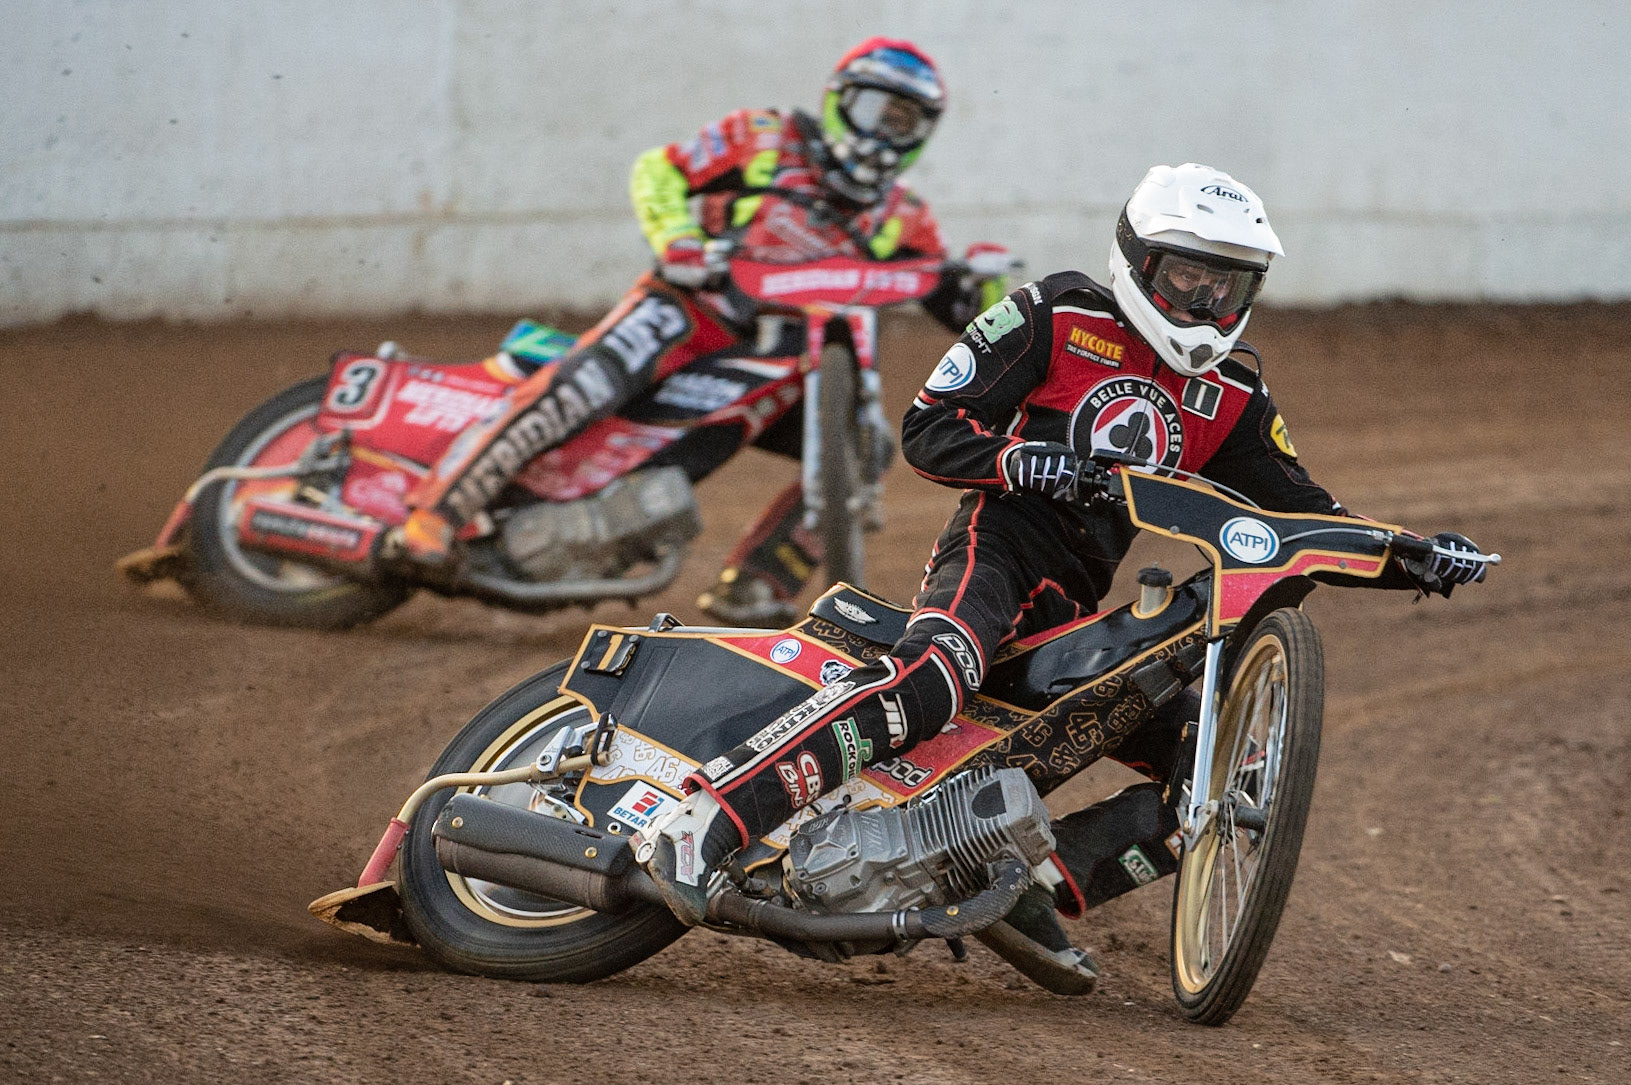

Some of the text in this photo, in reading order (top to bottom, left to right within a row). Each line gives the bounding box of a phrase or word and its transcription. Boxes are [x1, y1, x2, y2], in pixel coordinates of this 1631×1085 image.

[1069, 326, 1124, 361] HYCOTE
[335, 365, 377, 405] 3
[1089, 381, 1183, 454] BELLE VUE ACES
[1229, 531, 1268, 551] ATPI
[777, 645, 796, 658] ATPI
[838, 721, 858, 761] ROCK
[645, 755, 681, 784] 46
